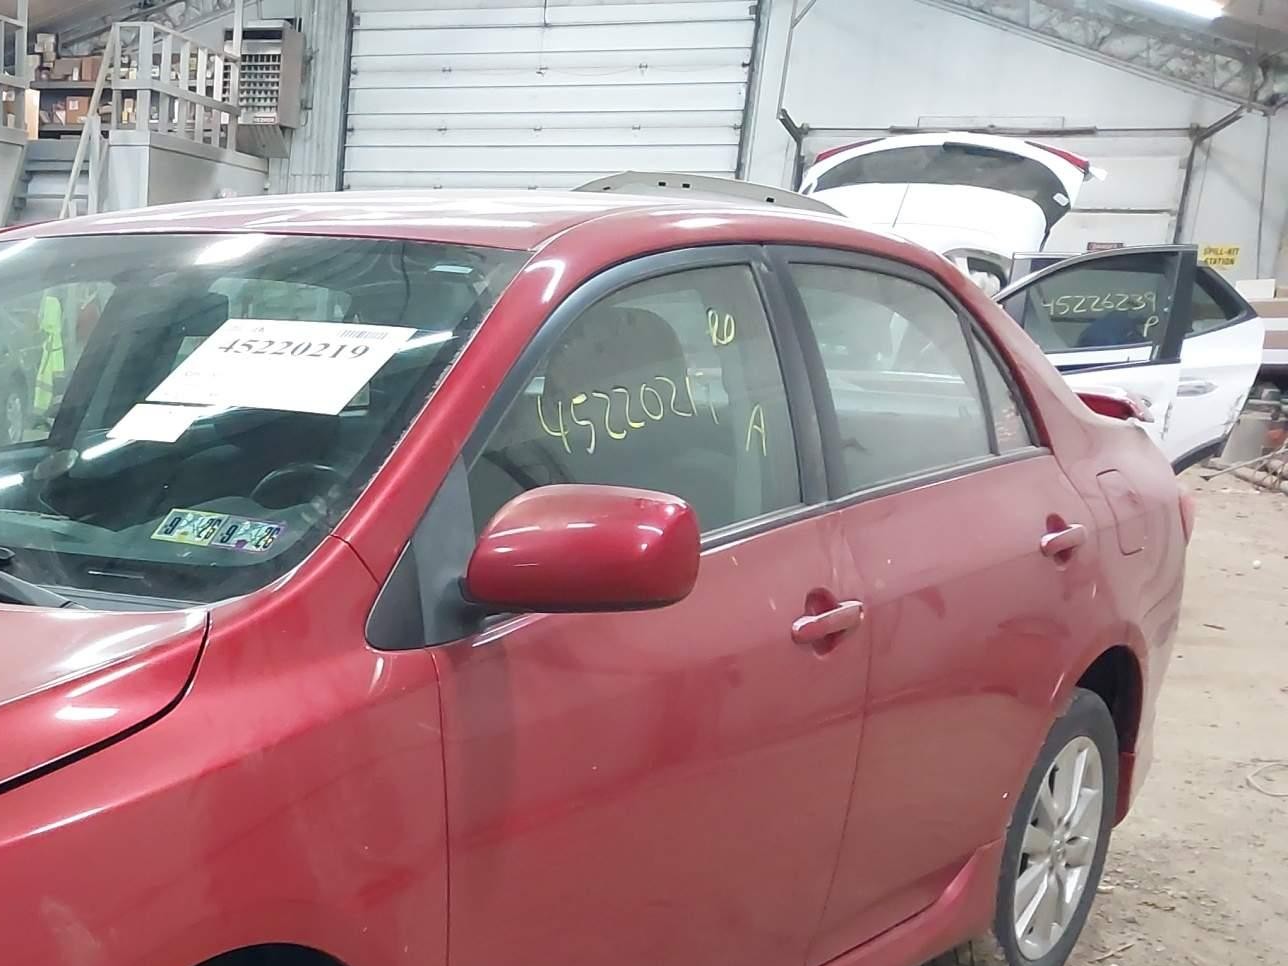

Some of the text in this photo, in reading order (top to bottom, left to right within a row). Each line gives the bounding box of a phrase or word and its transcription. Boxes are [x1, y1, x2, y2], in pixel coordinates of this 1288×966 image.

[218, 338, 370, 358] 45220219
[537, 372, 720, 454] 4522021
[746, 403, 767, 457] A
